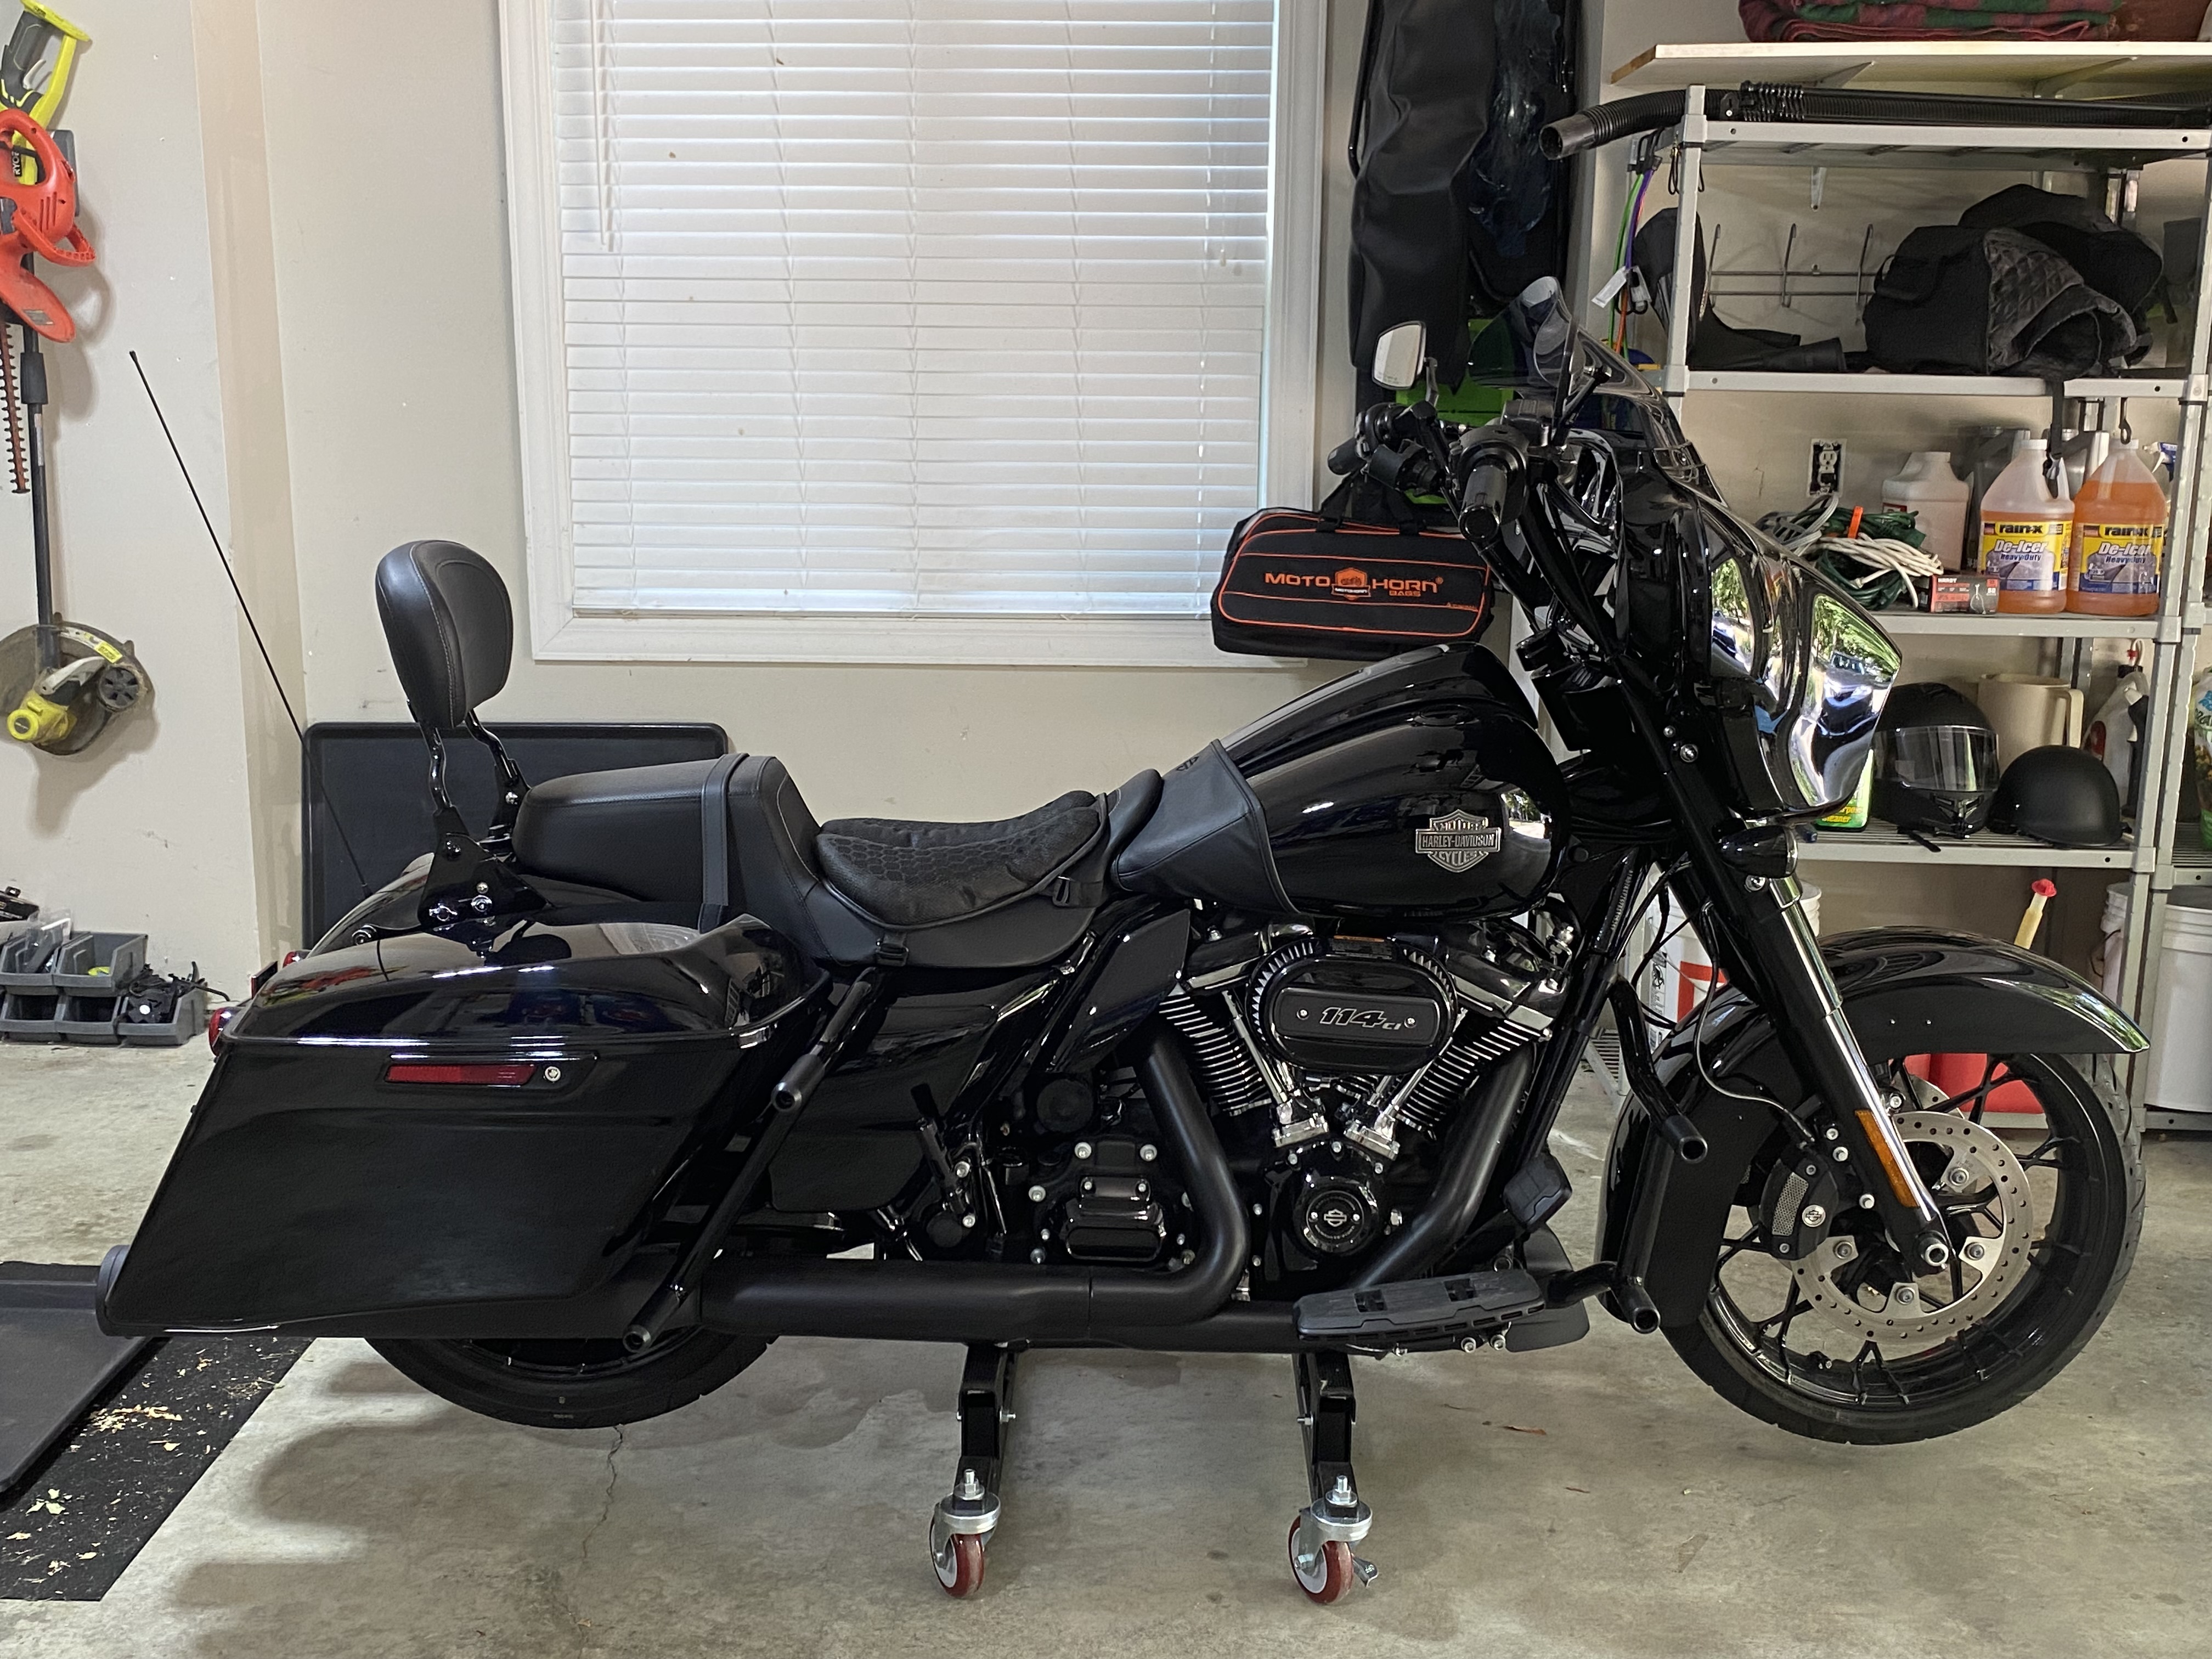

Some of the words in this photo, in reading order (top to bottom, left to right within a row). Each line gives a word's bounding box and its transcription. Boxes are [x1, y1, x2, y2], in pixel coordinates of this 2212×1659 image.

[1994, 539, 2049, 554] De-Icer
[1265, 573, 1330, 587] MOTO
[1422, 833, 1494, 848] HARLEY-DAVIDSON
[1438, 851, 1477, 866] CYCLES
